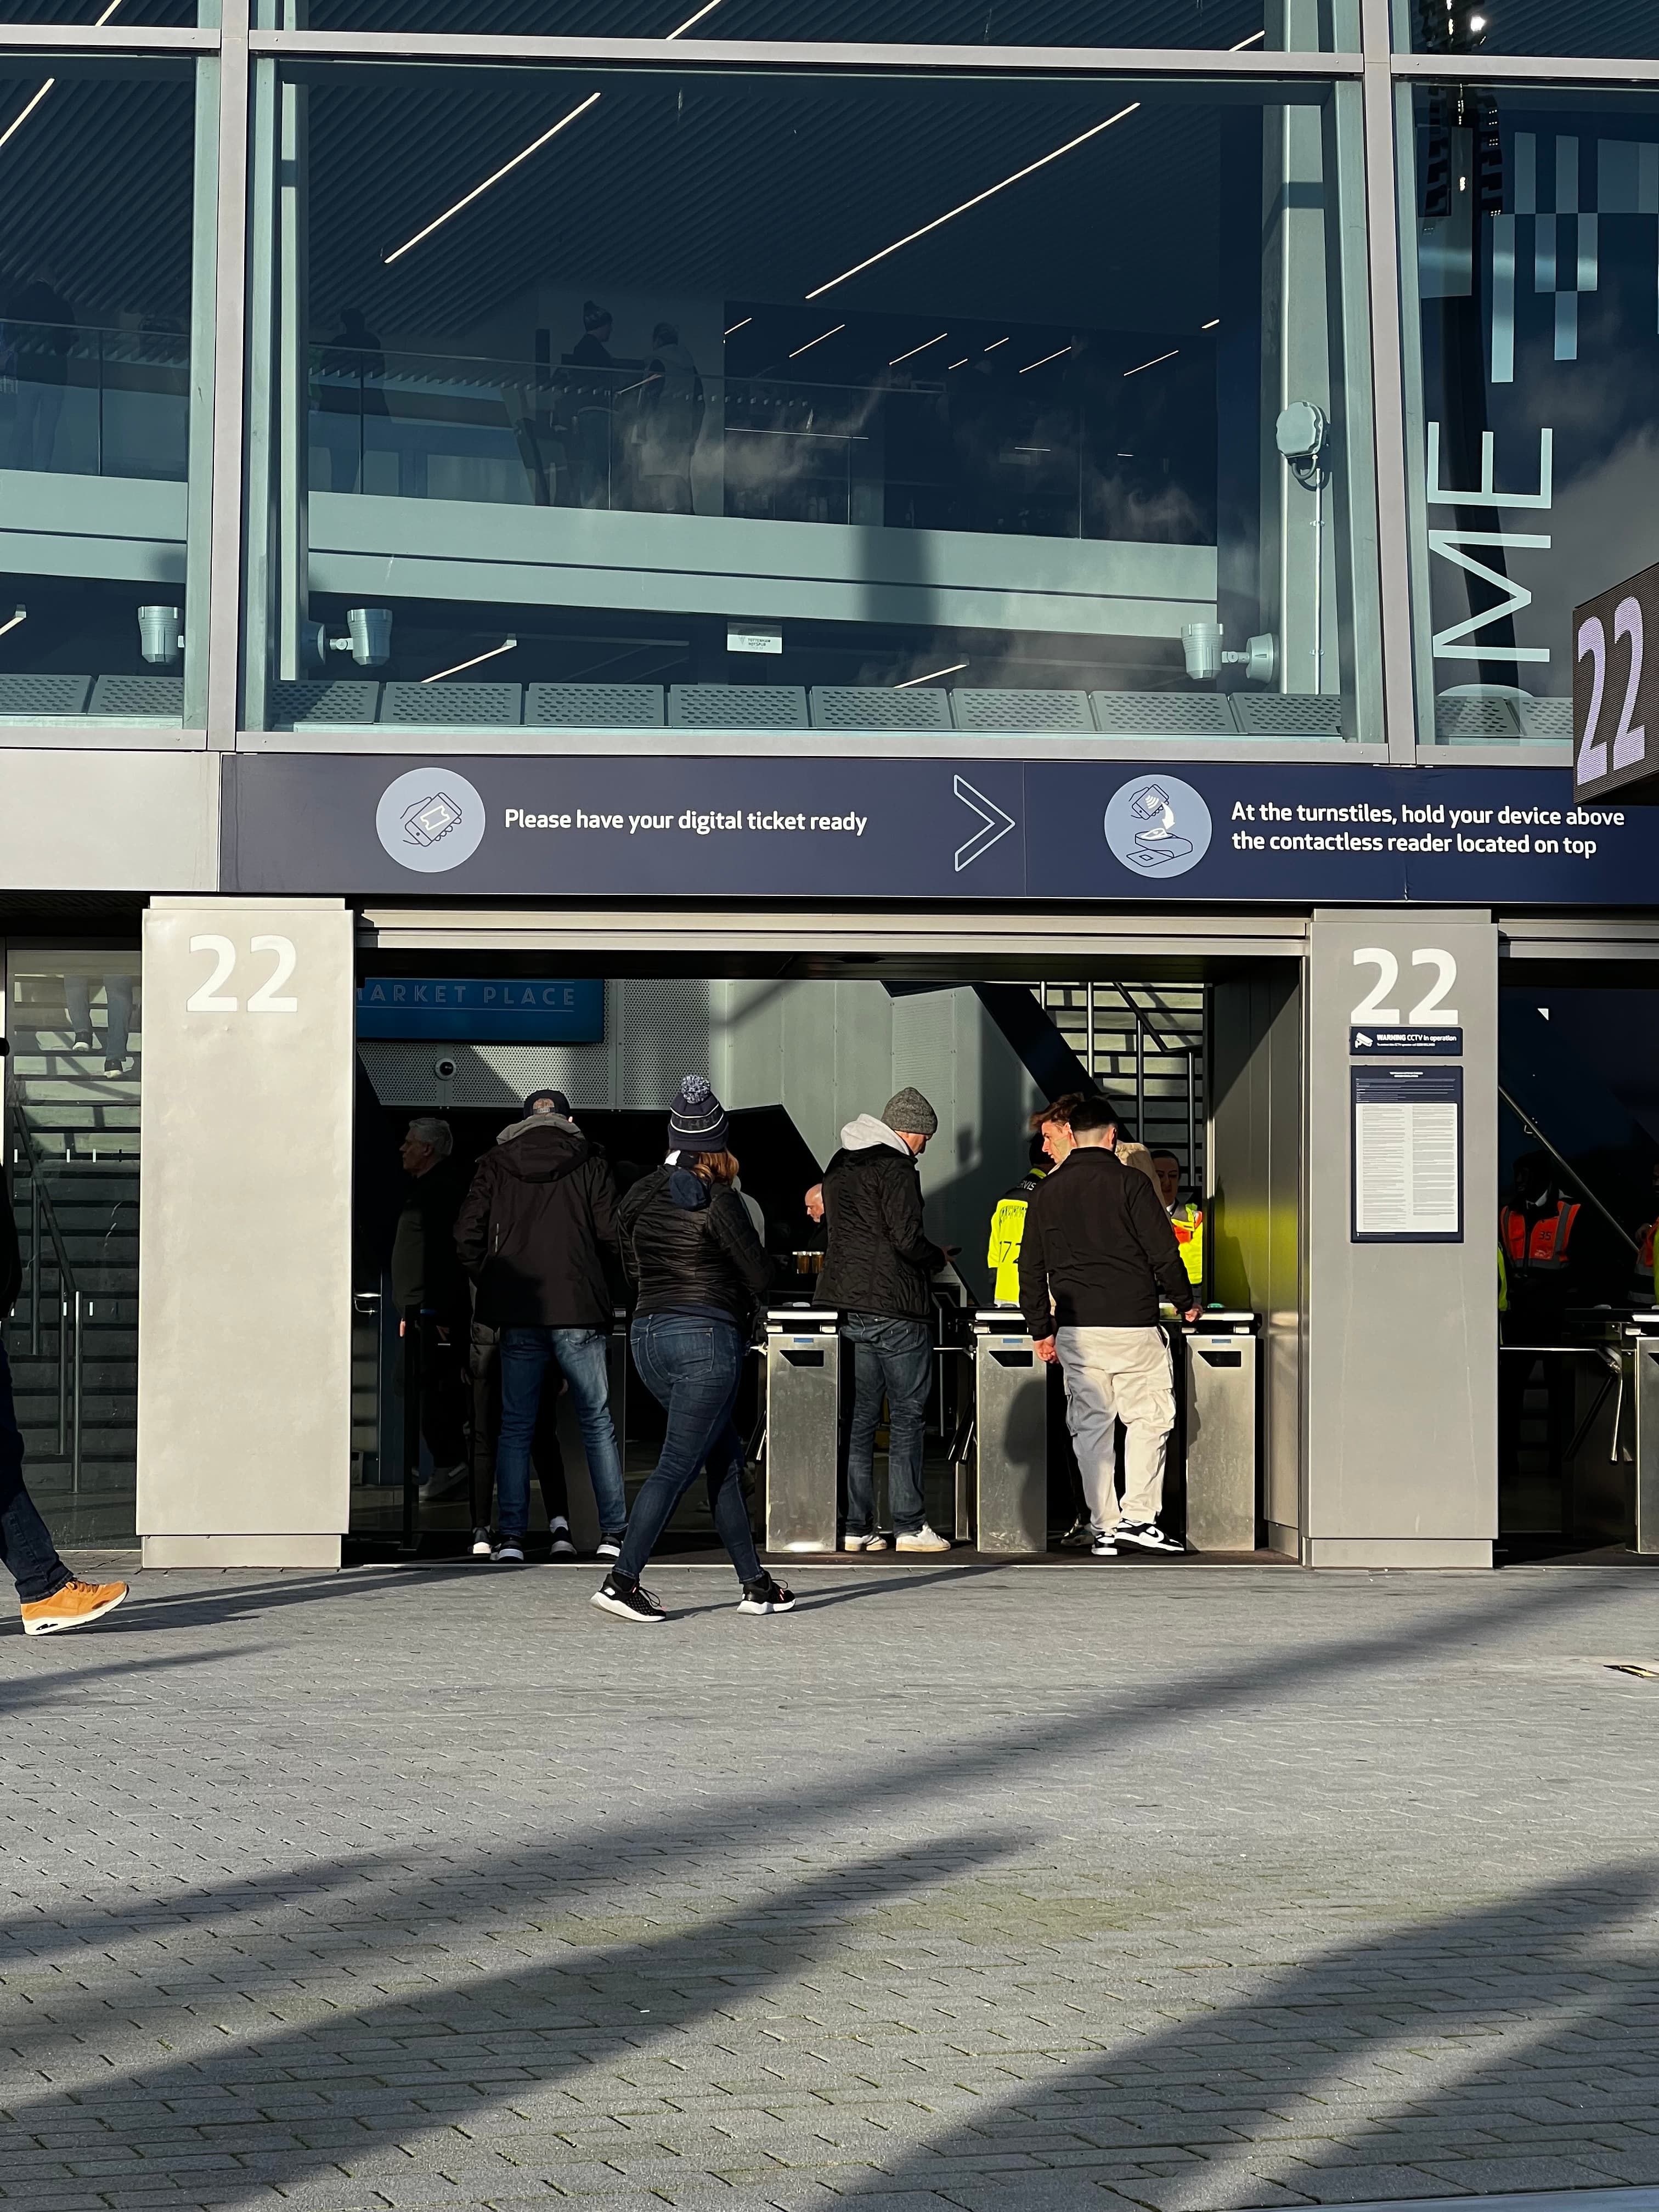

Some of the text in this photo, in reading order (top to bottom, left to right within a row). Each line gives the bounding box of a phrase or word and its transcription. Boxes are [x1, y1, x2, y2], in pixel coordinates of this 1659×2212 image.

[1577, 596, 1645, 786] 22
[504, 808, 868, 837] Please have your digital ticket ready
[1231, 800, 1625, 830] At the turnstiles, hold your device above
[1231, 831, 1597, 857] the contactless reader located on top
[186, 934, 298, 1013] 22
[1350, 947, 1459, 1025] 22
[484, 987, 574, 1005] PLACE
[1538, 1231, 1552, 1241] 35
